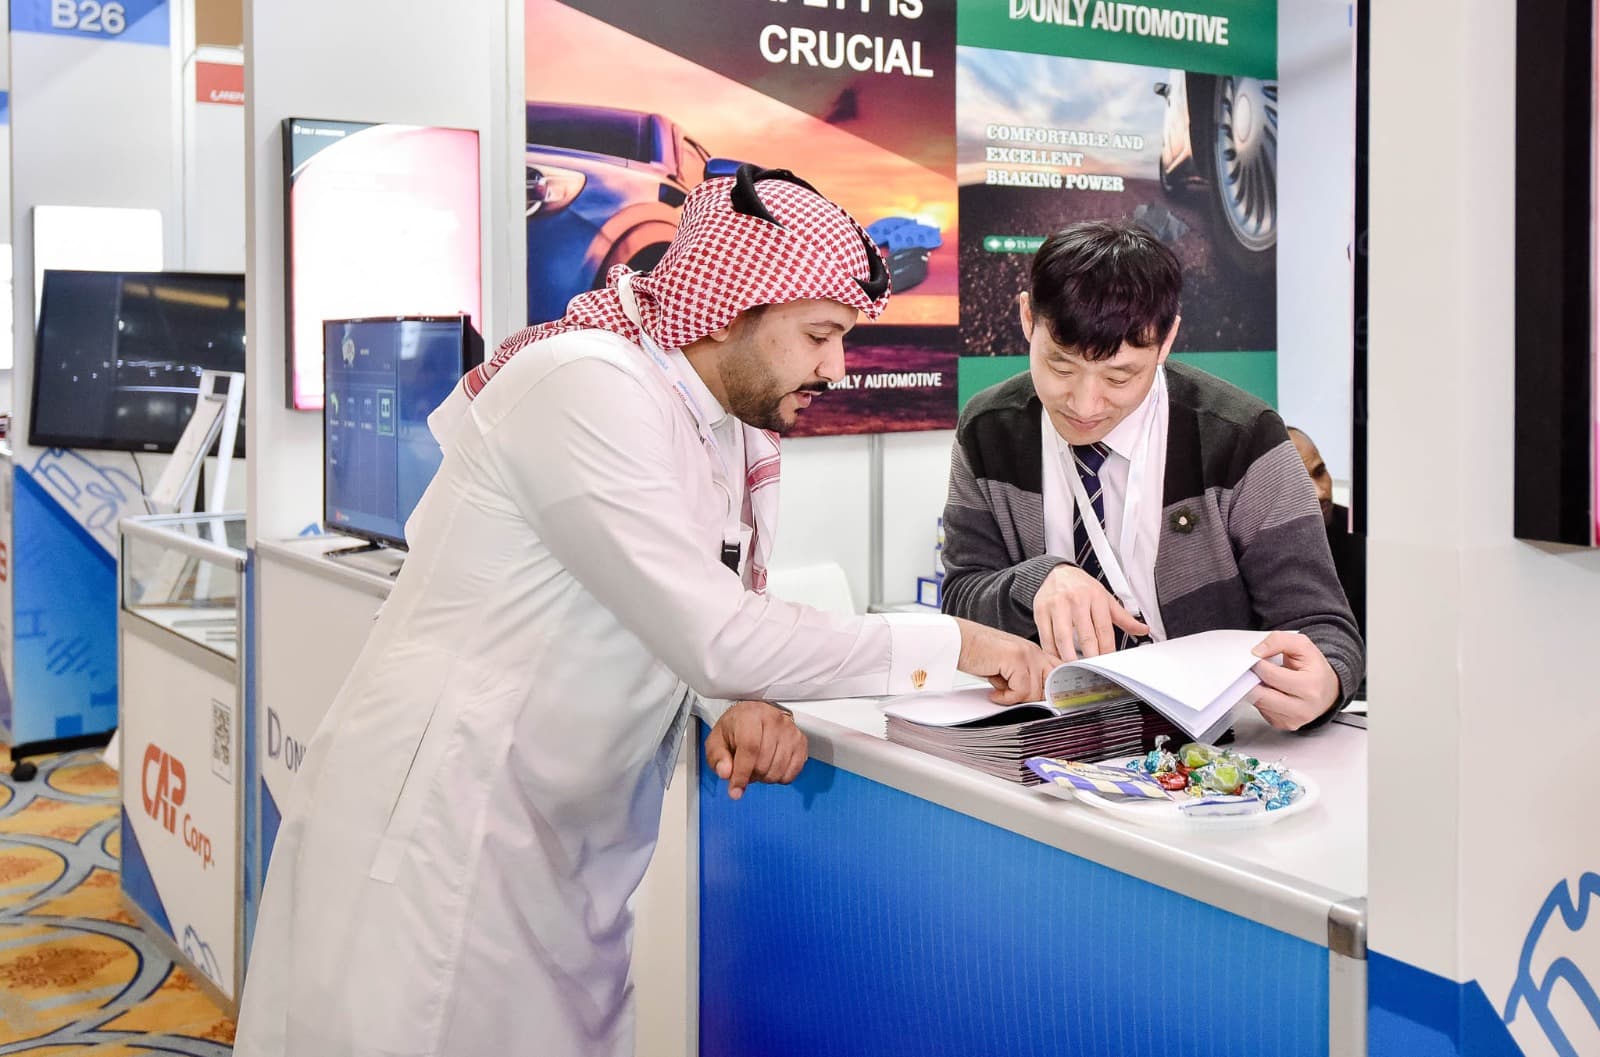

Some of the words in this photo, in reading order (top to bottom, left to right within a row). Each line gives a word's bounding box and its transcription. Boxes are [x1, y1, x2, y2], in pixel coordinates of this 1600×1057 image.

[52, 0, 125, 34] B26
[1091, 2, 1229, 45] AUTOMOTIVE
[759, 25, 934, 77] CRUCIAL
[986, 124, 1109, 146] COMFORTABLE
[1112, 134, 1144, 150] AND
[986, 147, 1084, 167] EXCELLENT
[986, 169, 1062, 189] BRAKING
[1065, 174, 1125, 192] POWER
[864, 372, 942, 389] AUTOMOTIVE
[183, 813, 215, 870] Corp.
